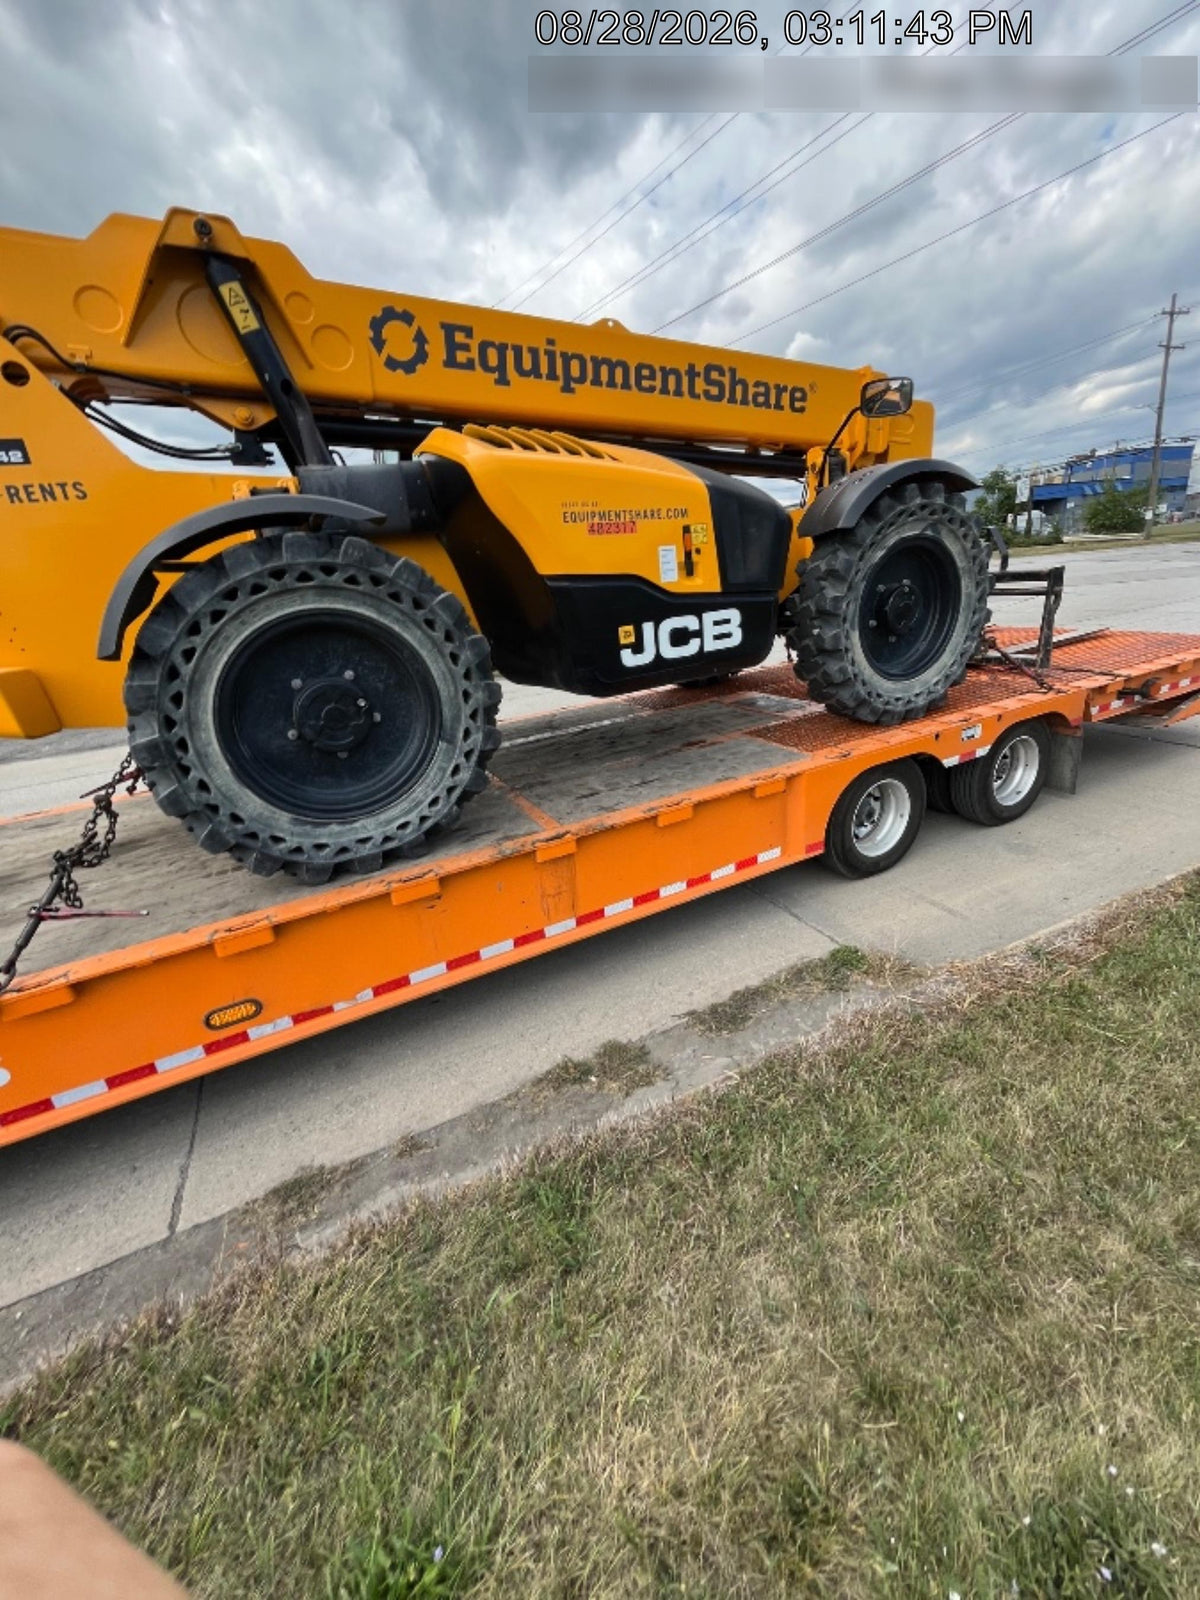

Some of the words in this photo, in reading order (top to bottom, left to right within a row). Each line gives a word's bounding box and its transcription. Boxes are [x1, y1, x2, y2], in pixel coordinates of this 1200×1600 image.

[439, 321, 808, 414] EquipmentShare
[563, 508, 689, 523] EQUIPMENTSHARE.COM
[619, 607, 743, 668] JCB
